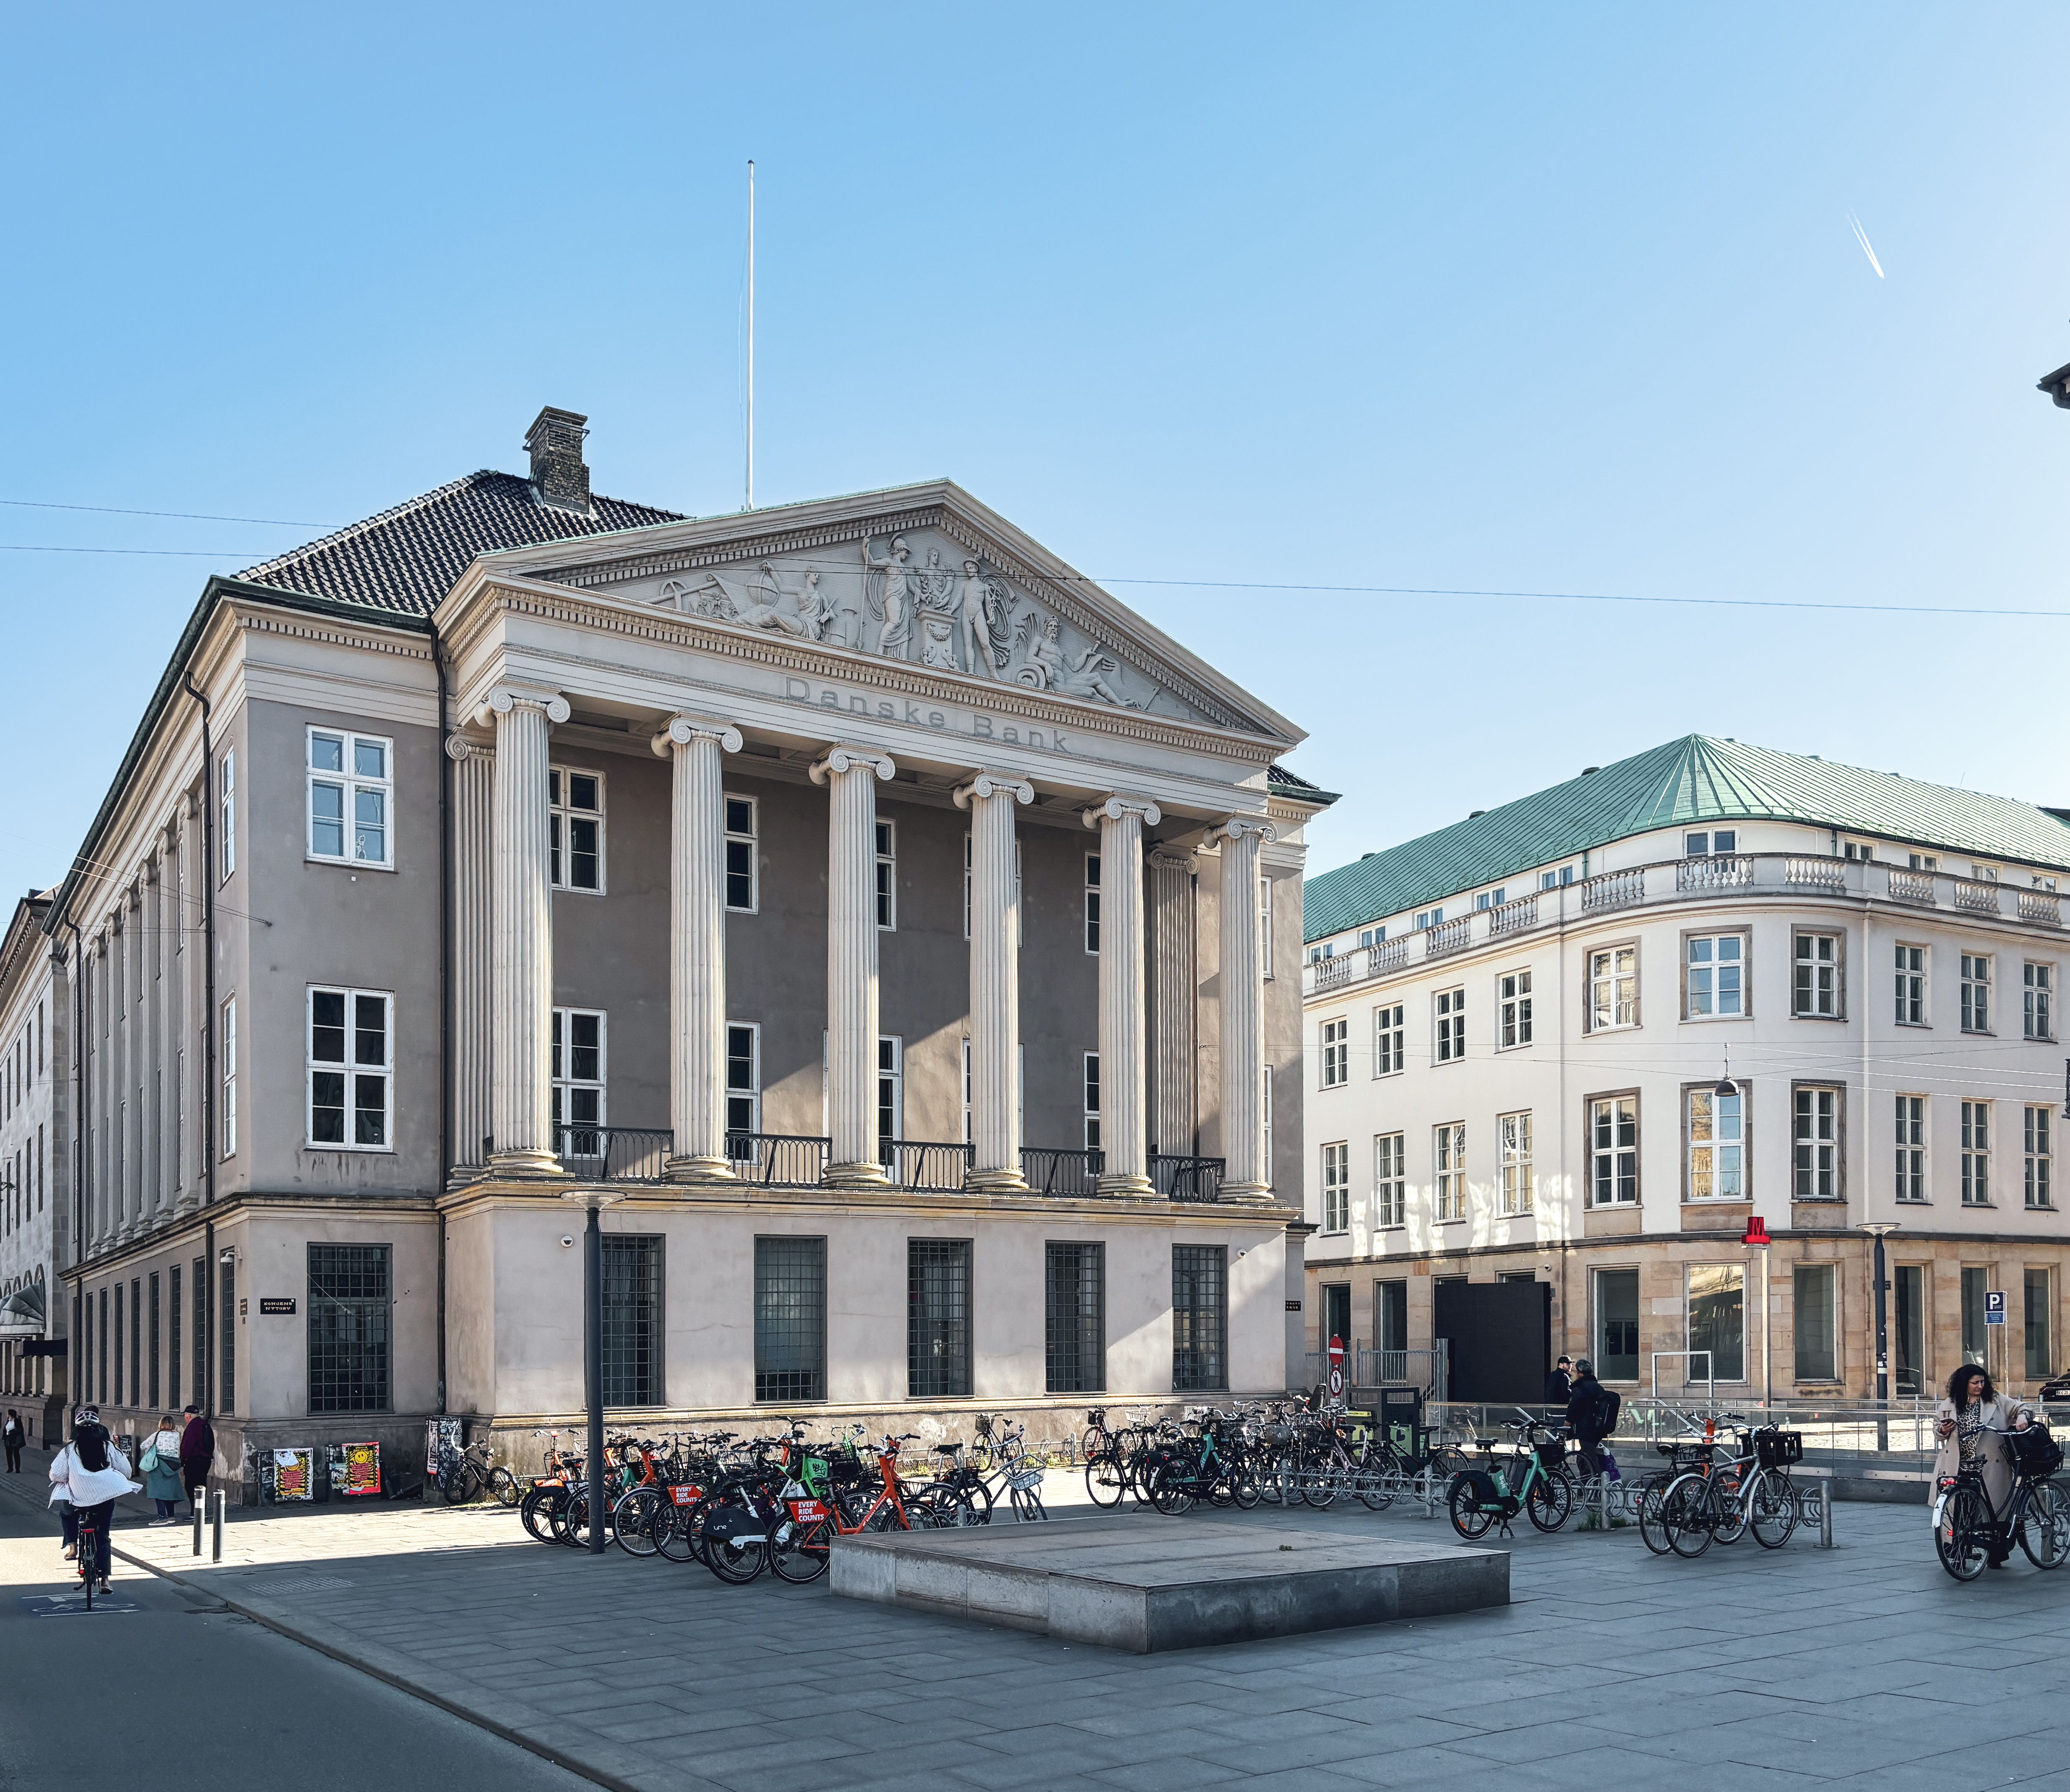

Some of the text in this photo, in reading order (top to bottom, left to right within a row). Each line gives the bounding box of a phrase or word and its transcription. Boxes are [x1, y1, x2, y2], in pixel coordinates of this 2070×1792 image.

[786, 676, 1070, 753] Danske Bank
[1990, 1294, 2000, 1310] P
